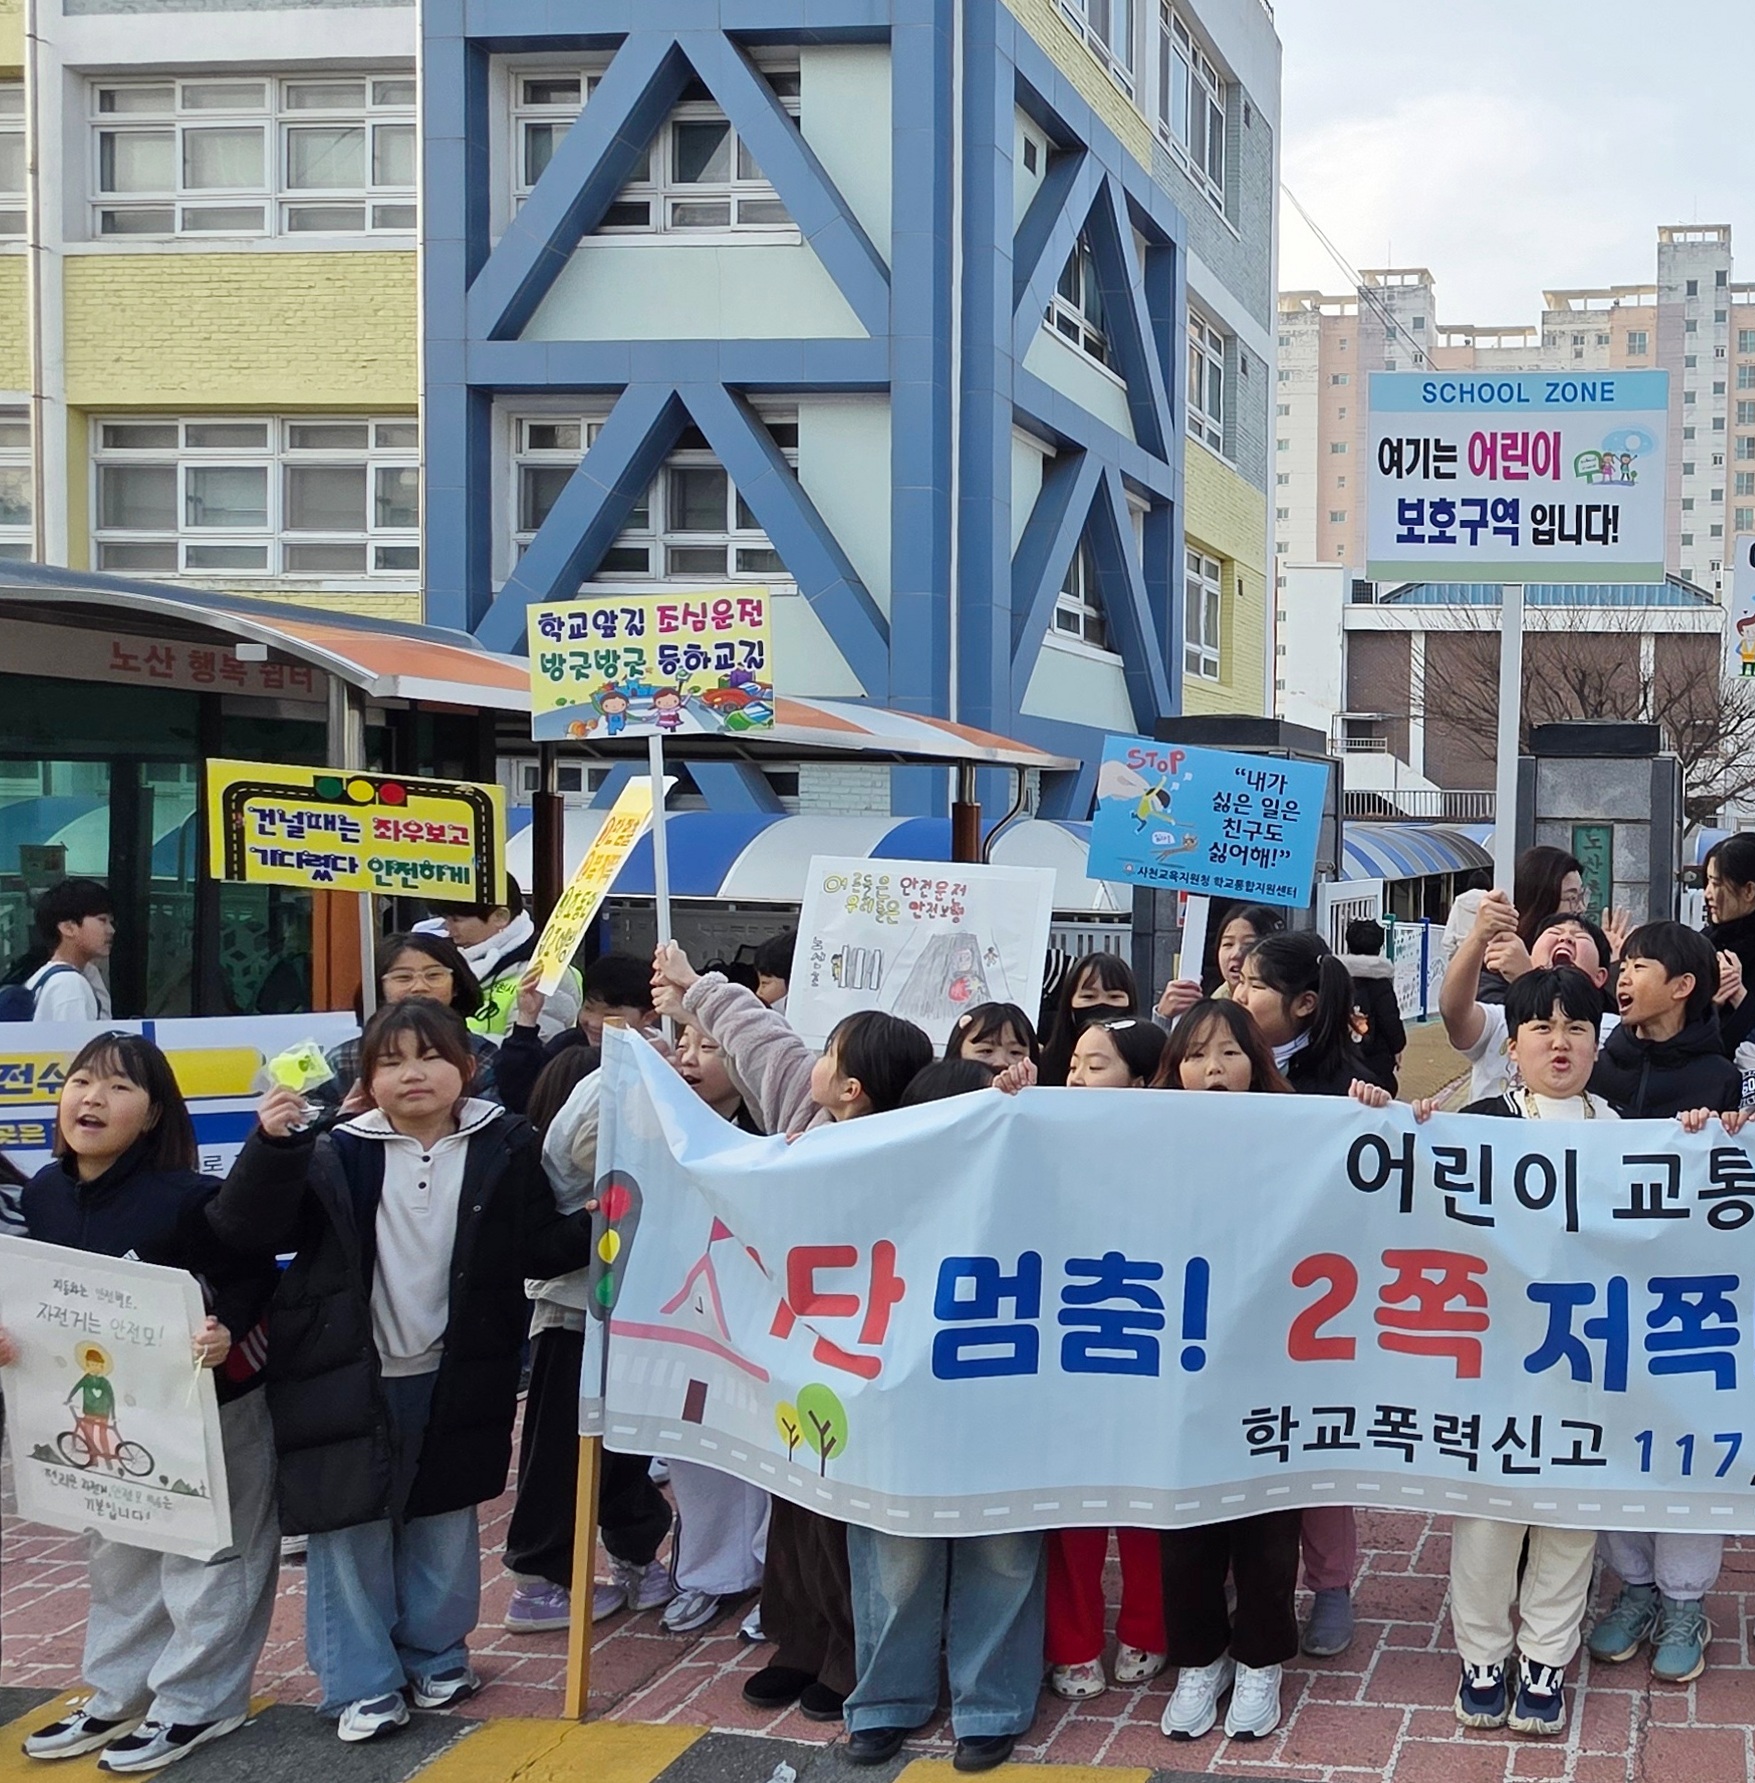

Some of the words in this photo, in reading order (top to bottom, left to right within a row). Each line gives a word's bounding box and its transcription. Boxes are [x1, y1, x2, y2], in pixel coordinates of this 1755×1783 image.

[1422, 382, 1530, 404] SCHOOL
[1545, 381, 1615, 403] ZONE
[1378, 437, 1457, 480] 여기는
[1468, 431, 1561, 481] 어린이
[1396, 498, 1519, 546] 보호구역
[1531, 504, 1619, 546] 입니다!
[538, 608, 645, 643] 학교앞길
[656, 599, 763, 633] 조심운전
[109, 641, 176, 679] 노산
[187, 649, 248, 687] 행복
[540, 648, 646, 682] 방긋방긋
[658, 640, 764, 675] 등하교길
[1127, 749, 1186, 775] STOP
[248, 806, 361, 843] 건널때는
[372, 817, 470, 846] 좌우보고
[1212, 792, 1253, 815] 싫은
[1261, 797, 1301, 822] 일은
[1222, 818, 1283, 842] 친구도
[249, 846, 359, 881] 기다렸다
[367, 857, 470, 889] 안전하게
[1137, 866, 1211, 889] 사천교육지원청
[1213, 876, 1297, 898] 학교통합지원센터
[1346, 1132, 1580, 1232] 어린이
[36, 1302, 101, 1334] 자전거는
[109, 1317, 165, 1347] 안전모!
[930, 1250, 1210, 1381] 멈춤!
[1287, 1248, 1490, 1380] 2쪽
[1241, 1403, 1609, 1476] 학교폭력신고
